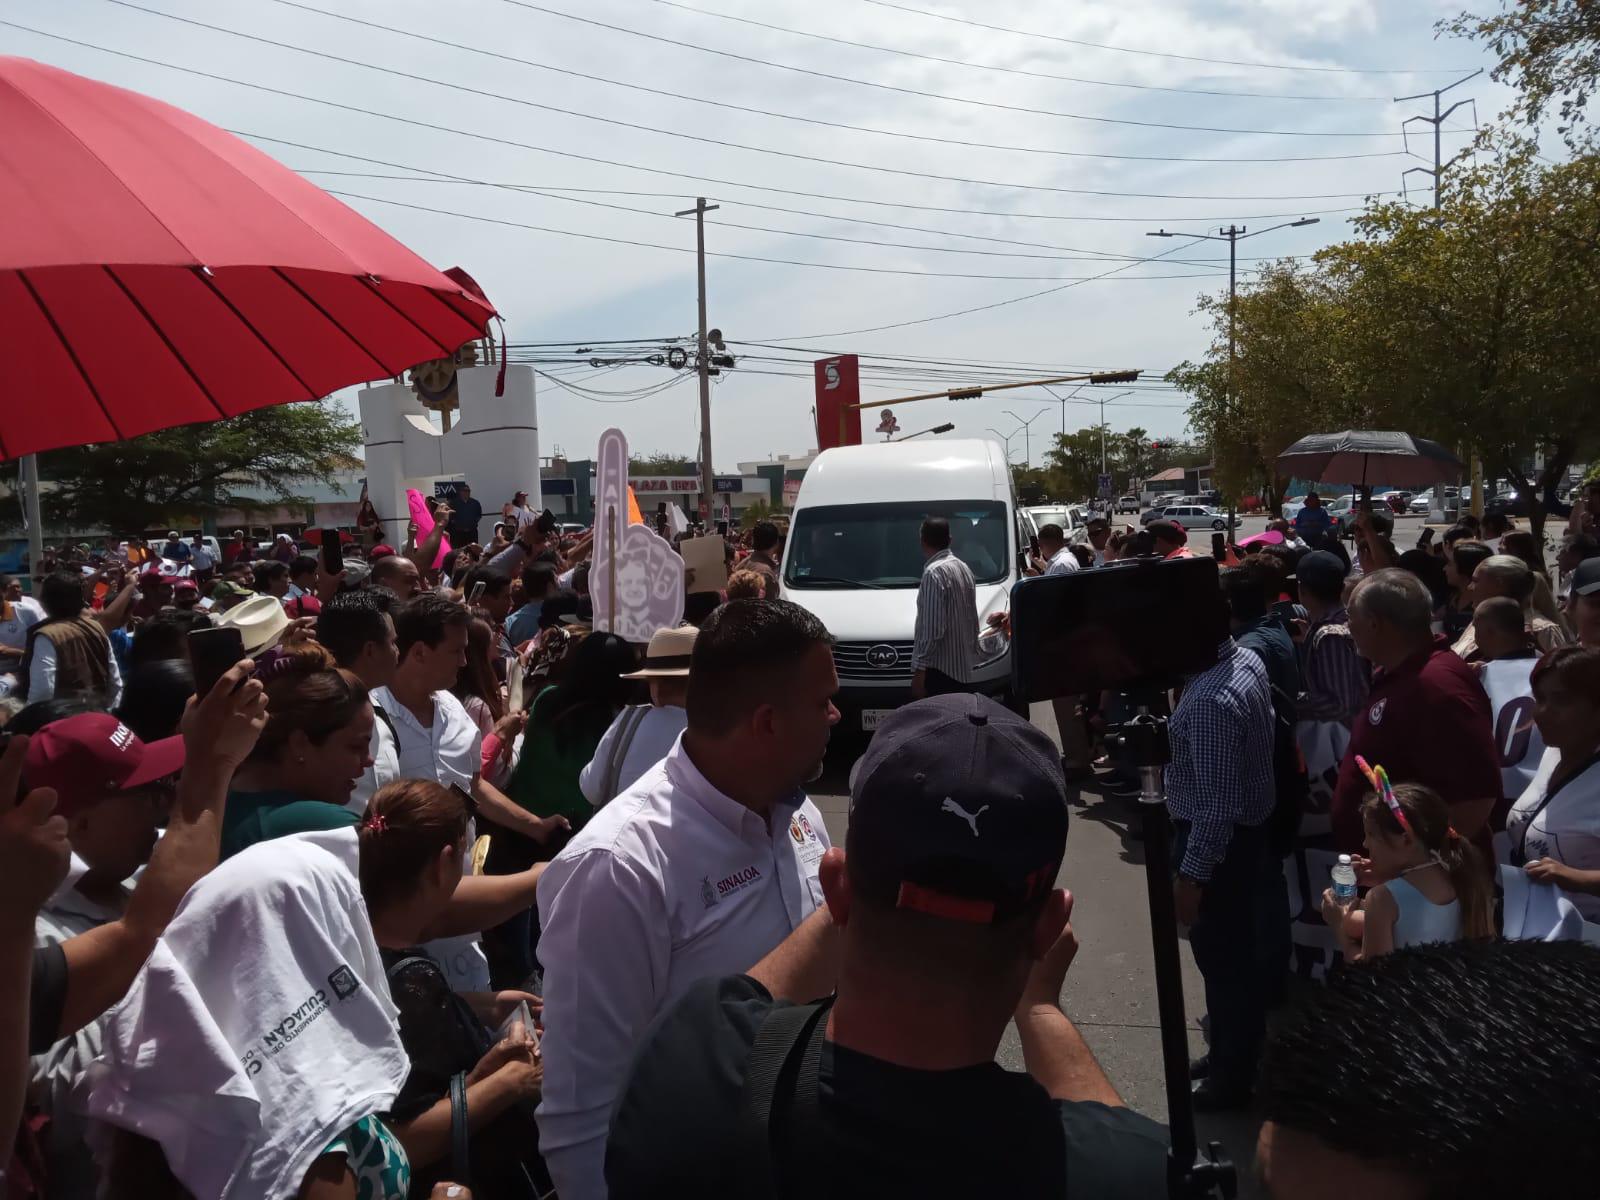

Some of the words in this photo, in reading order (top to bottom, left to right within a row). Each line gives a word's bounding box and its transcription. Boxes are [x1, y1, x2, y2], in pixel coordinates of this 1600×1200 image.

[717, 866, 760, 893] SINALOA
[263, 989, 326, 1046] CULIACÁN
[284, 999, 331, 1043] AYUNTAMIENTO
[271, 1041, 286, 1055] DE
